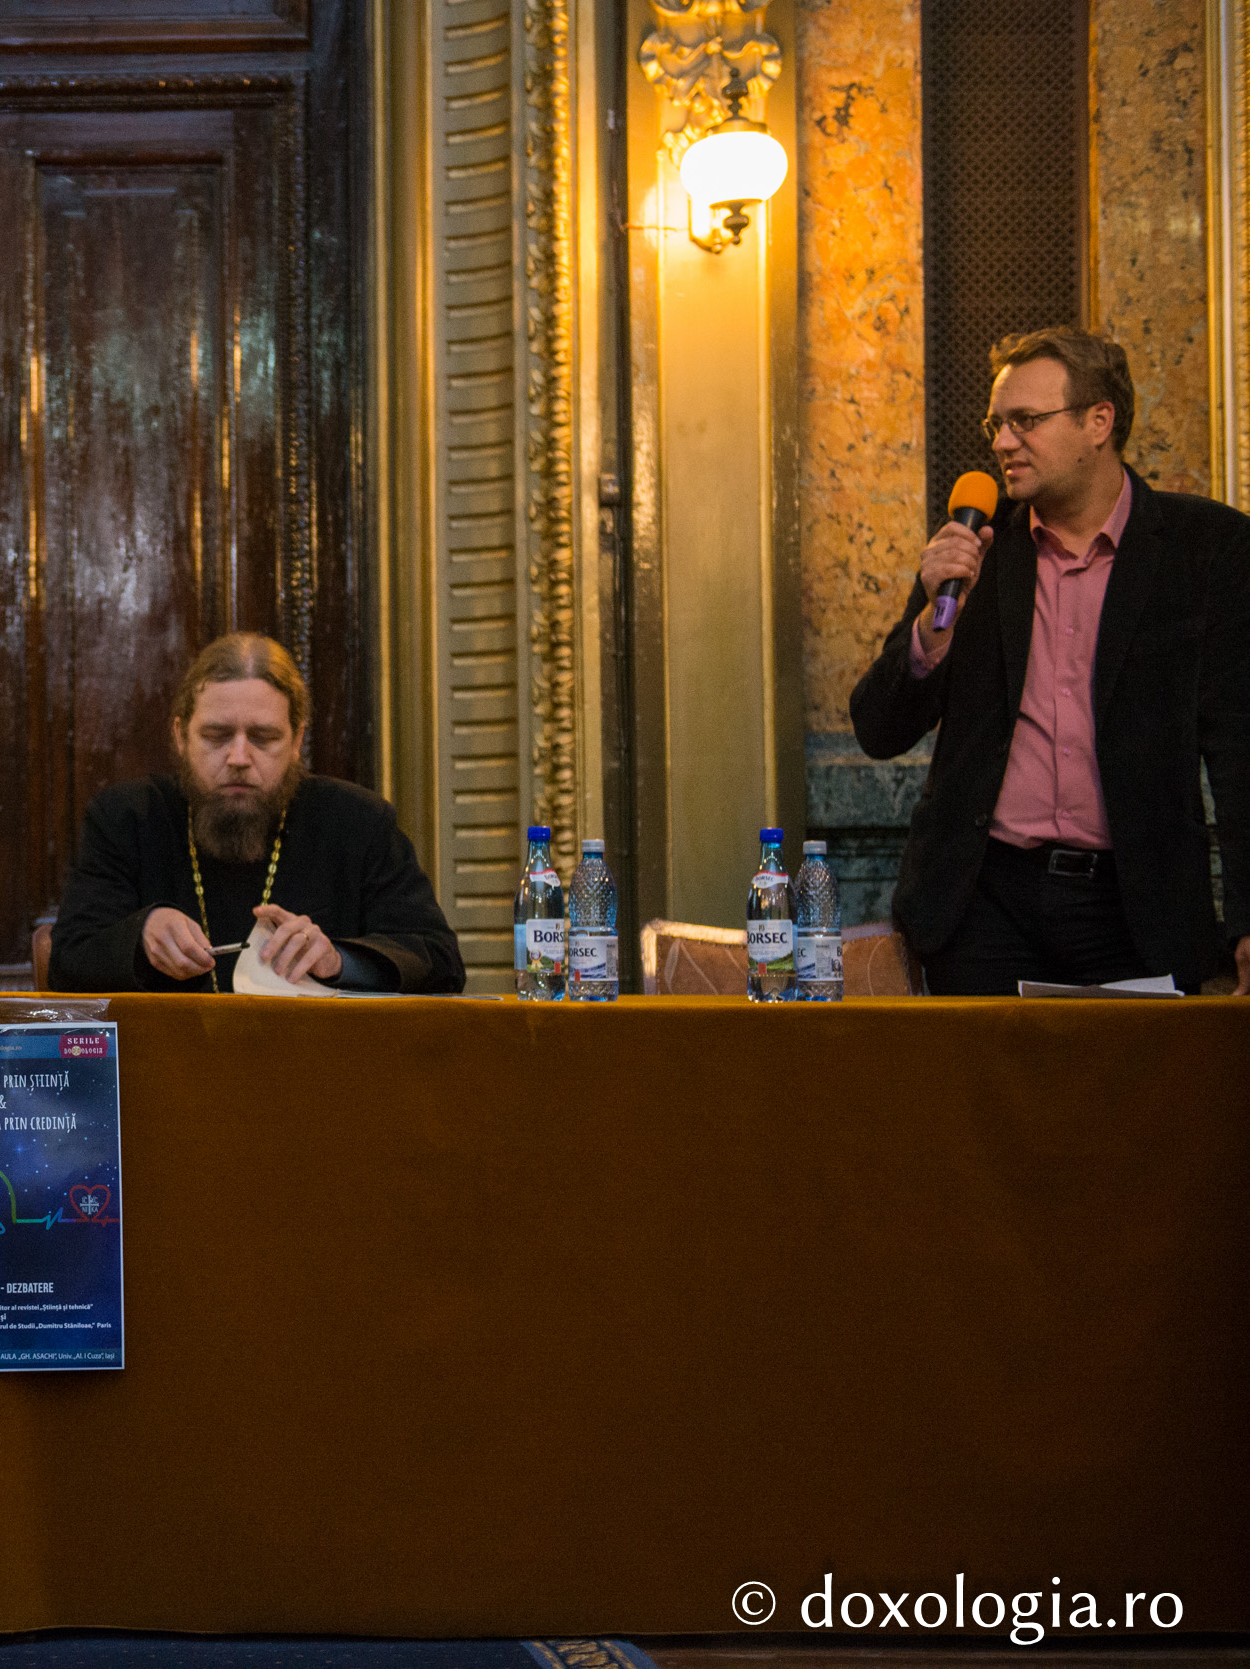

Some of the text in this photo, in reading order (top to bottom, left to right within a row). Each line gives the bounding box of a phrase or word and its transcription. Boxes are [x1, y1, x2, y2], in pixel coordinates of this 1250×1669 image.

[3, 1074, 26, 1088] PRIN
[30, 1071, 70, 1092] ȘTIINȚĂ
[4, 1117, 28, 1130] PRIN
[30, 1112, 76, 1134] CREDINȚĂ
[6, 1282, 54, 1294] DEZBATERE
